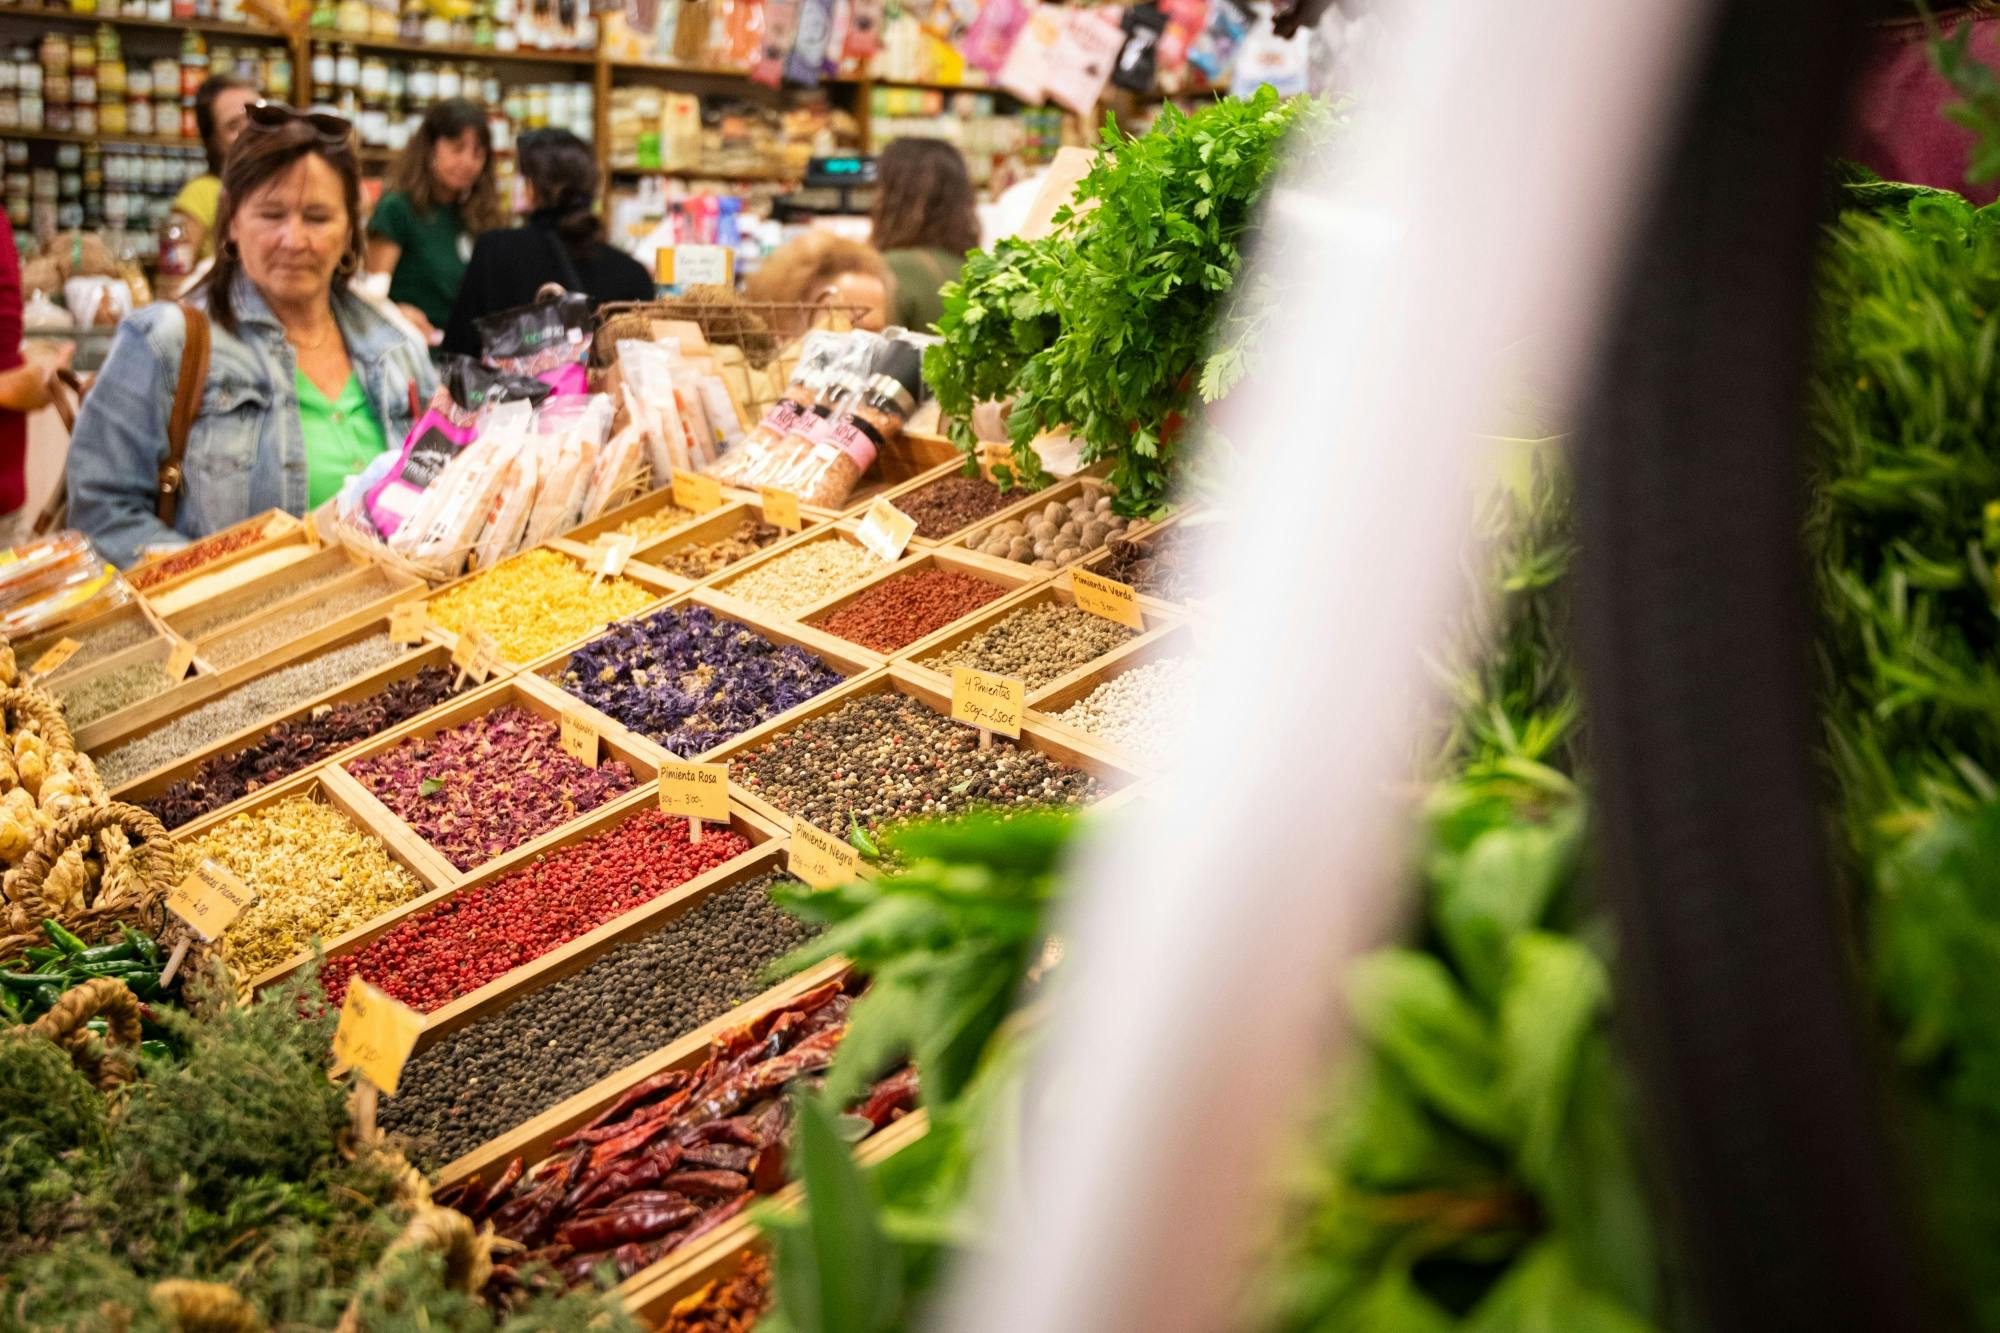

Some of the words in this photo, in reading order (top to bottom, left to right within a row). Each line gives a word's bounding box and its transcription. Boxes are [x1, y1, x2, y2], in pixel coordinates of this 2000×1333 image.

[1072, 572, 1108, 593] Pimienta
[1108, 584, 1134, 602] Verde
[964, 677, 972, 692] 4
[973, 675, 1011, 701] Pimientas
[660, 765, 697, 783] Pimienta
[697, 770, 718, 785] Rosa
[796, 822, 828, 853] Pimienta
[828, 843, 854, 868] Negra
